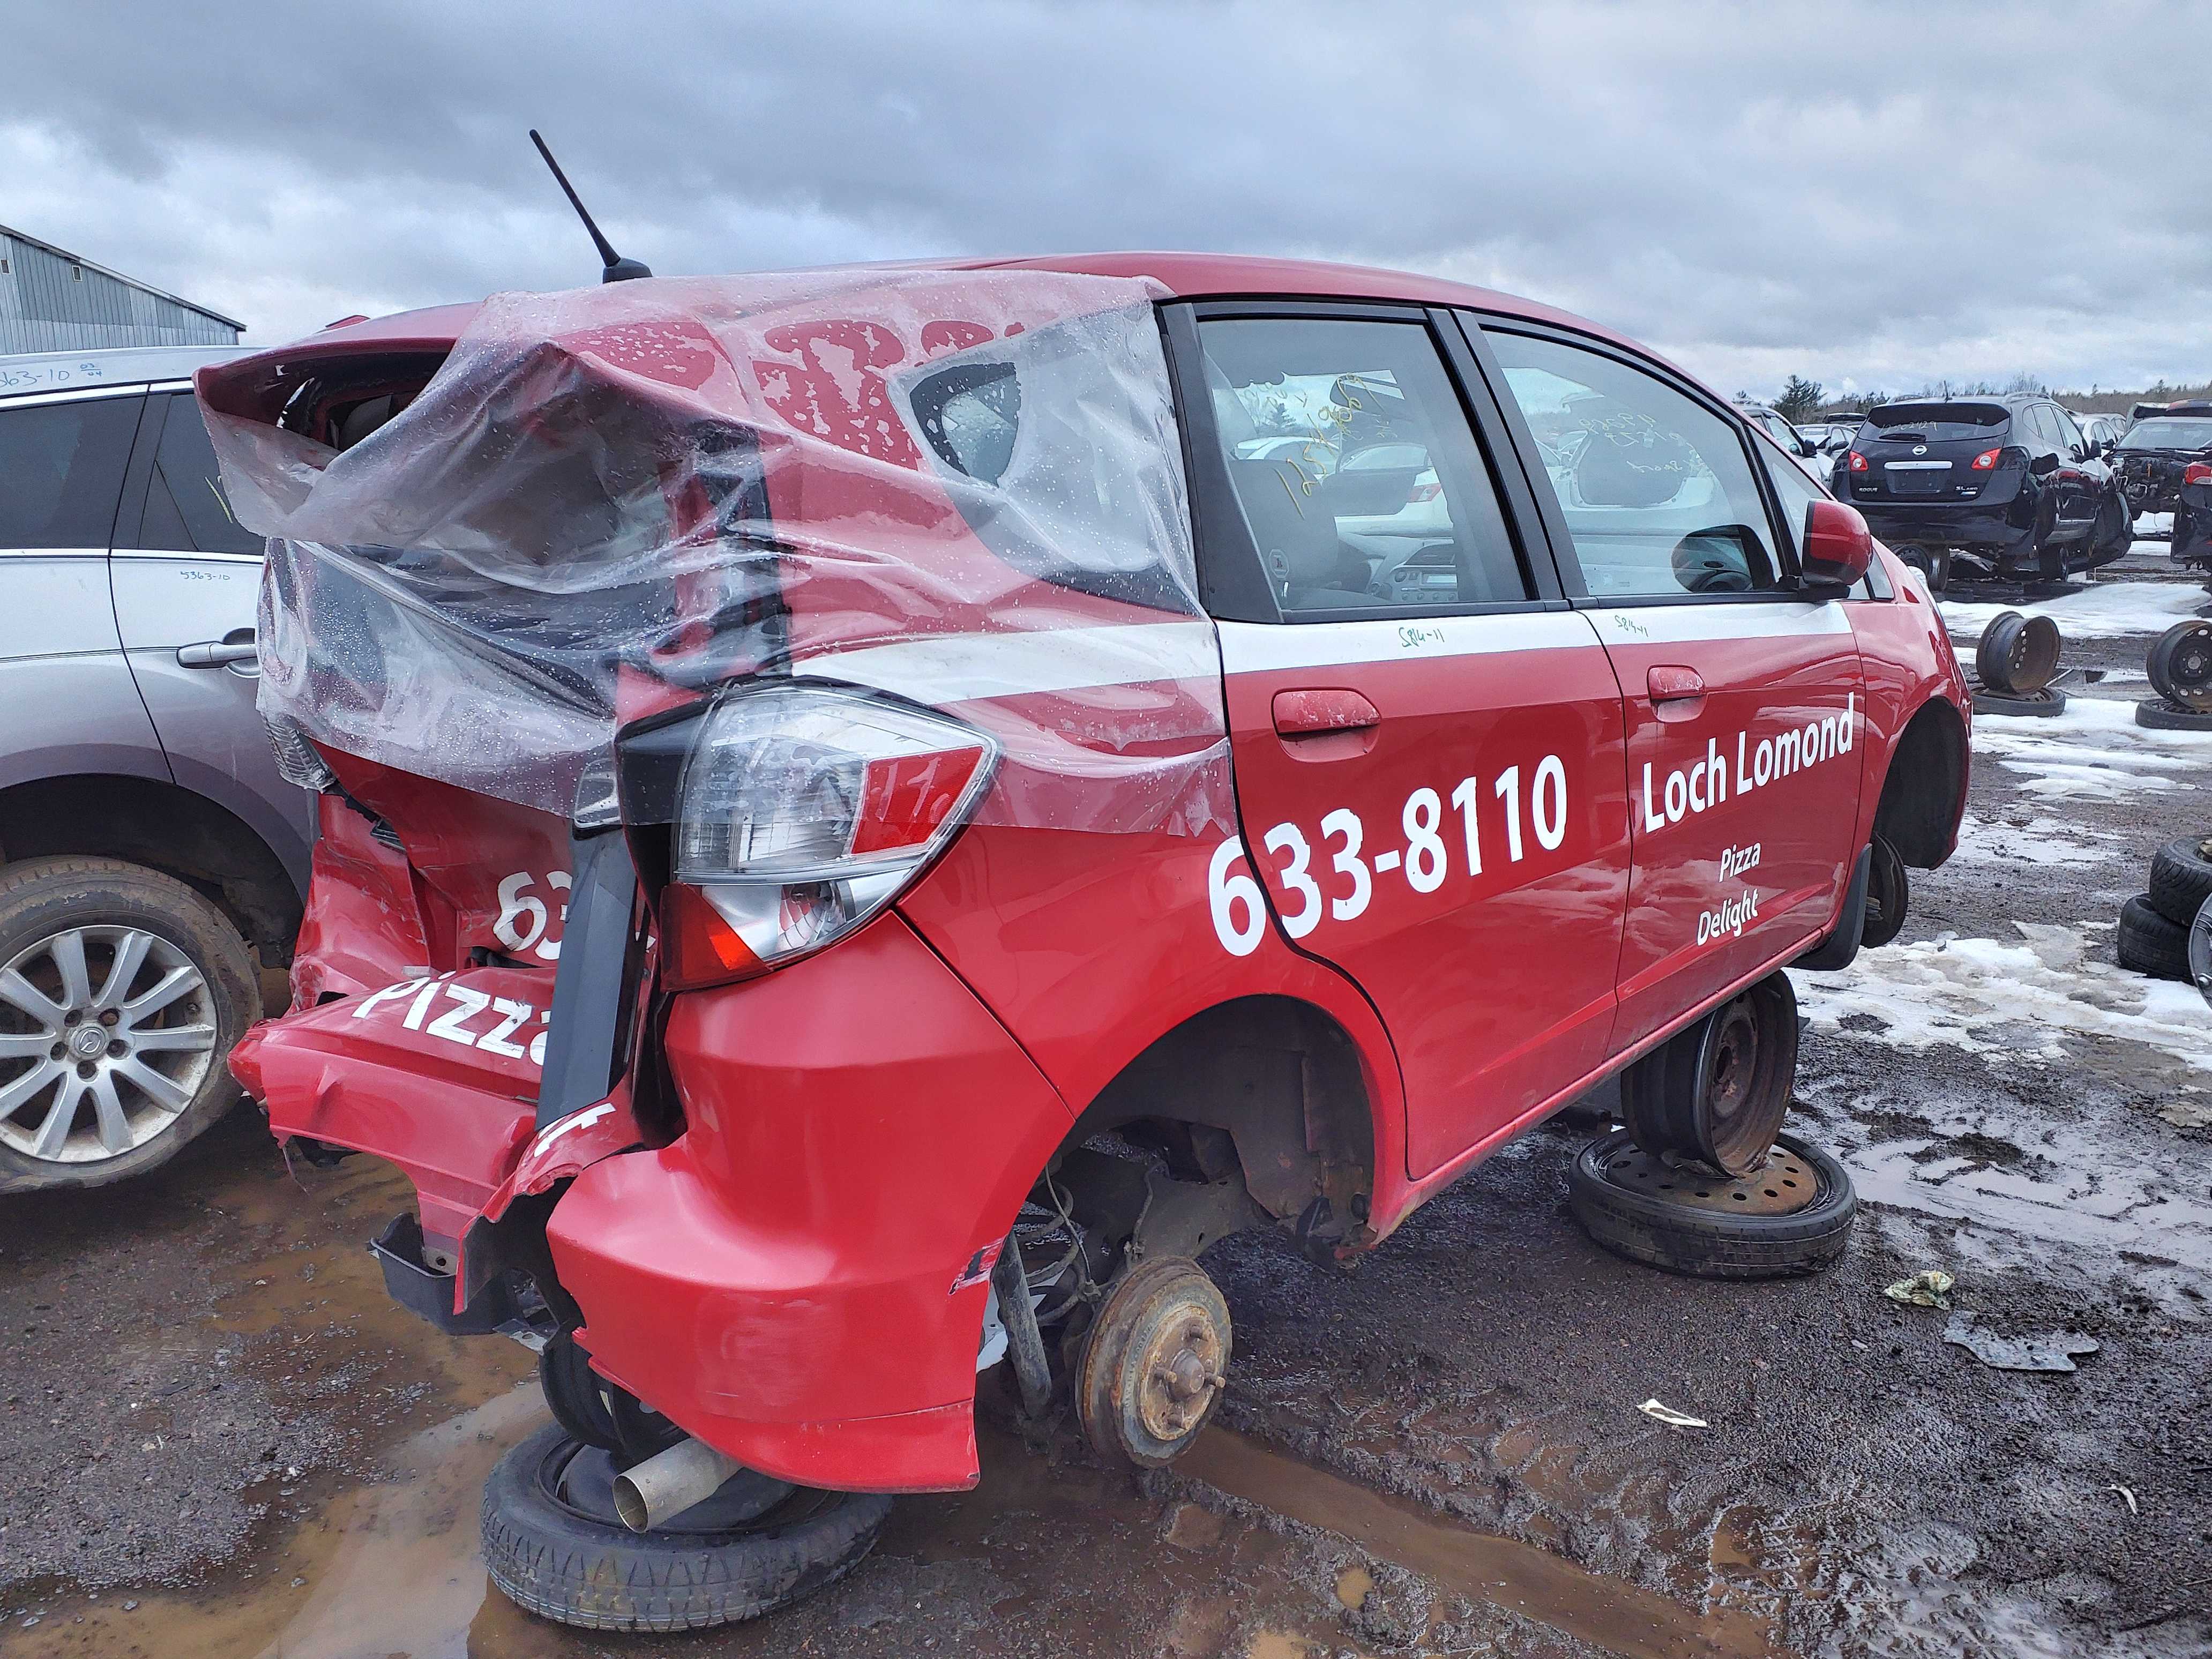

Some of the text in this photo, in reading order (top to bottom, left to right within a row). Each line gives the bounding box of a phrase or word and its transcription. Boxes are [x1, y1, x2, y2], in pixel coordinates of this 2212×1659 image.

[180, 571, 230, 580] 5363-10
[1643, 691, 1855, 834] Loch Lomond
[1208, 754, 1567, 957] 633-8110
[1718, 842, 1761, 883] Pizza
[1697, 888, 1759, 946] Delight
